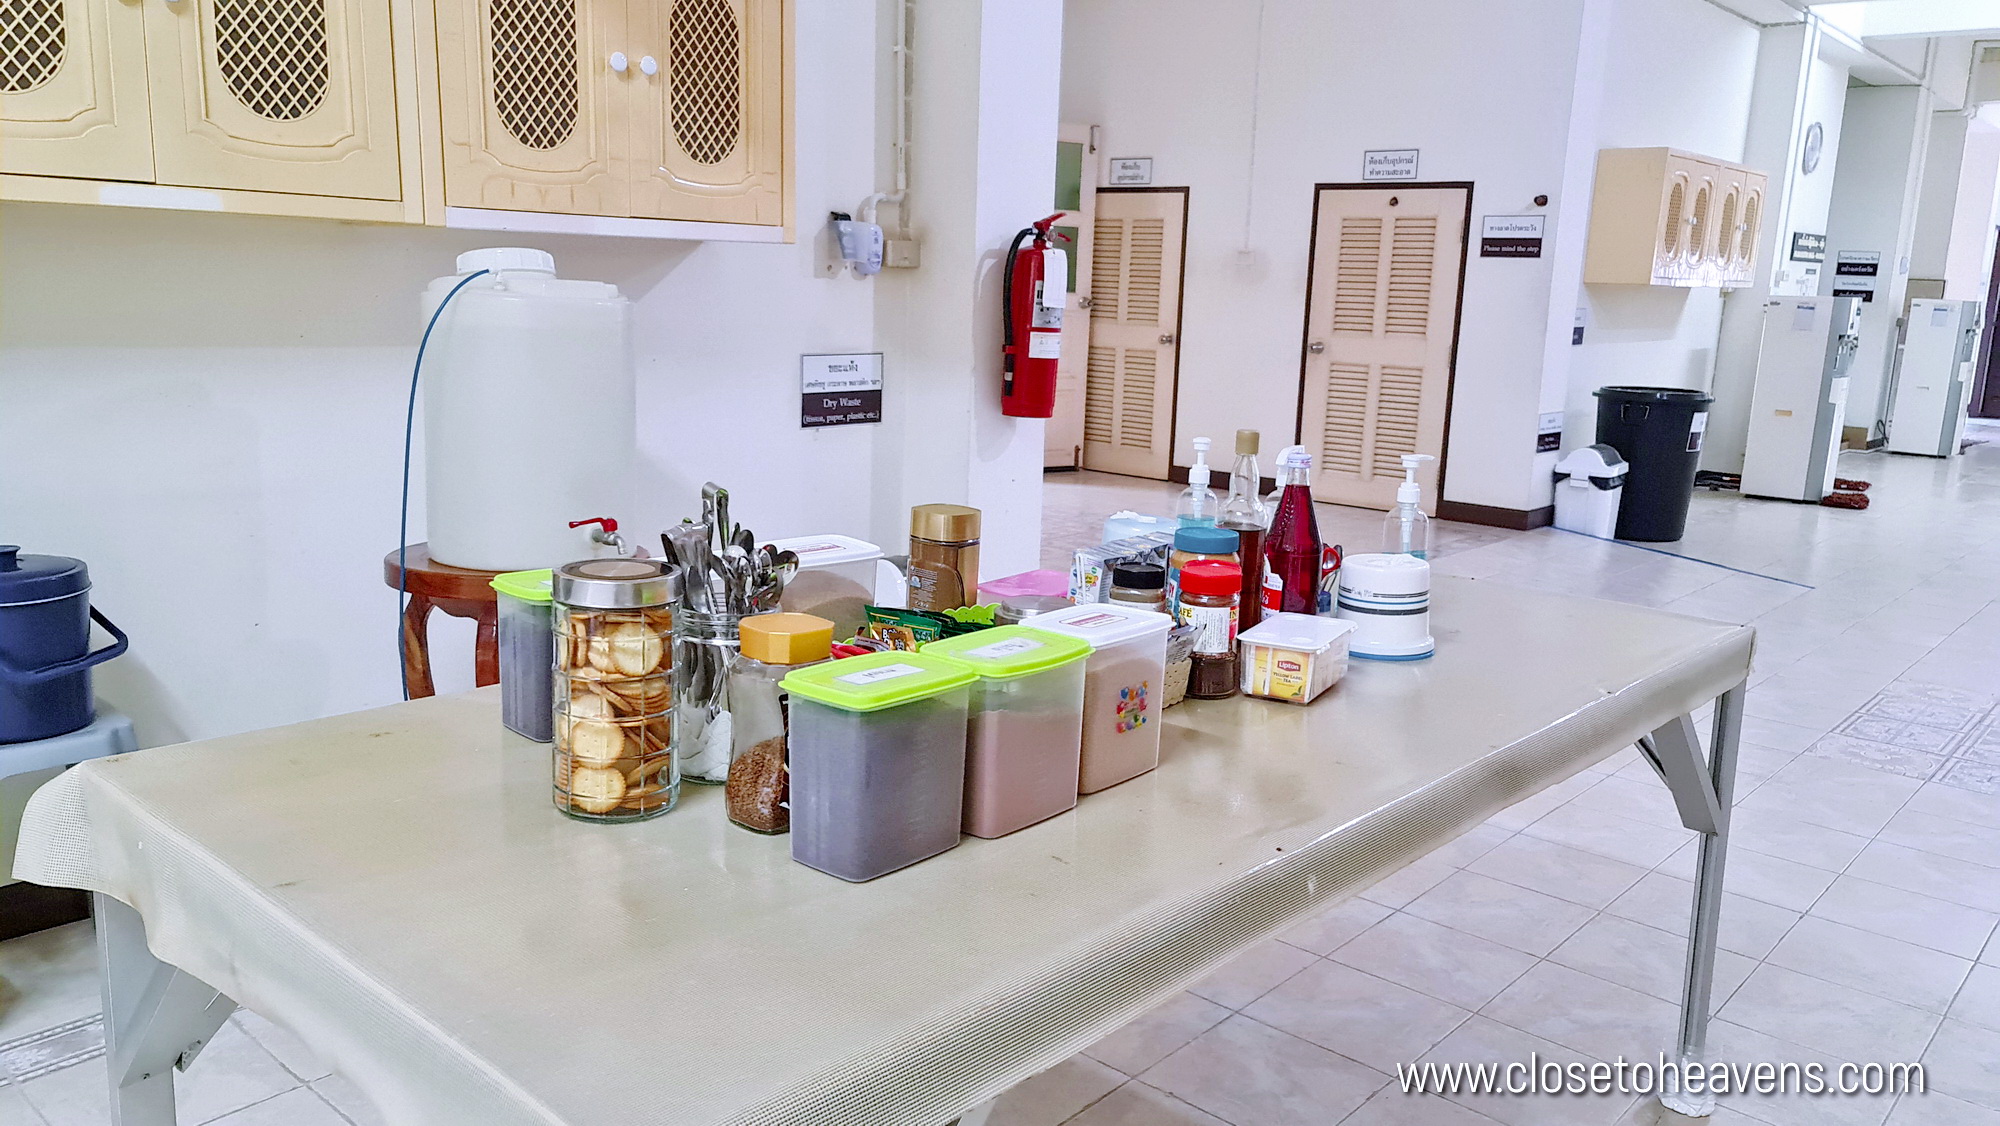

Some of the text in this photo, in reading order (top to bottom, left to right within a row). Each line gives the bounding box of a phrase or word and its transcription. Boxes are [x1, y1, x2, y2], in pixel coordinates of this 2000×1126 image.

[1526, 246, 1540, 254] step
[823, 397, 861, 410] Dry Waste
[1279, 661, 1299, 670] Lipton
